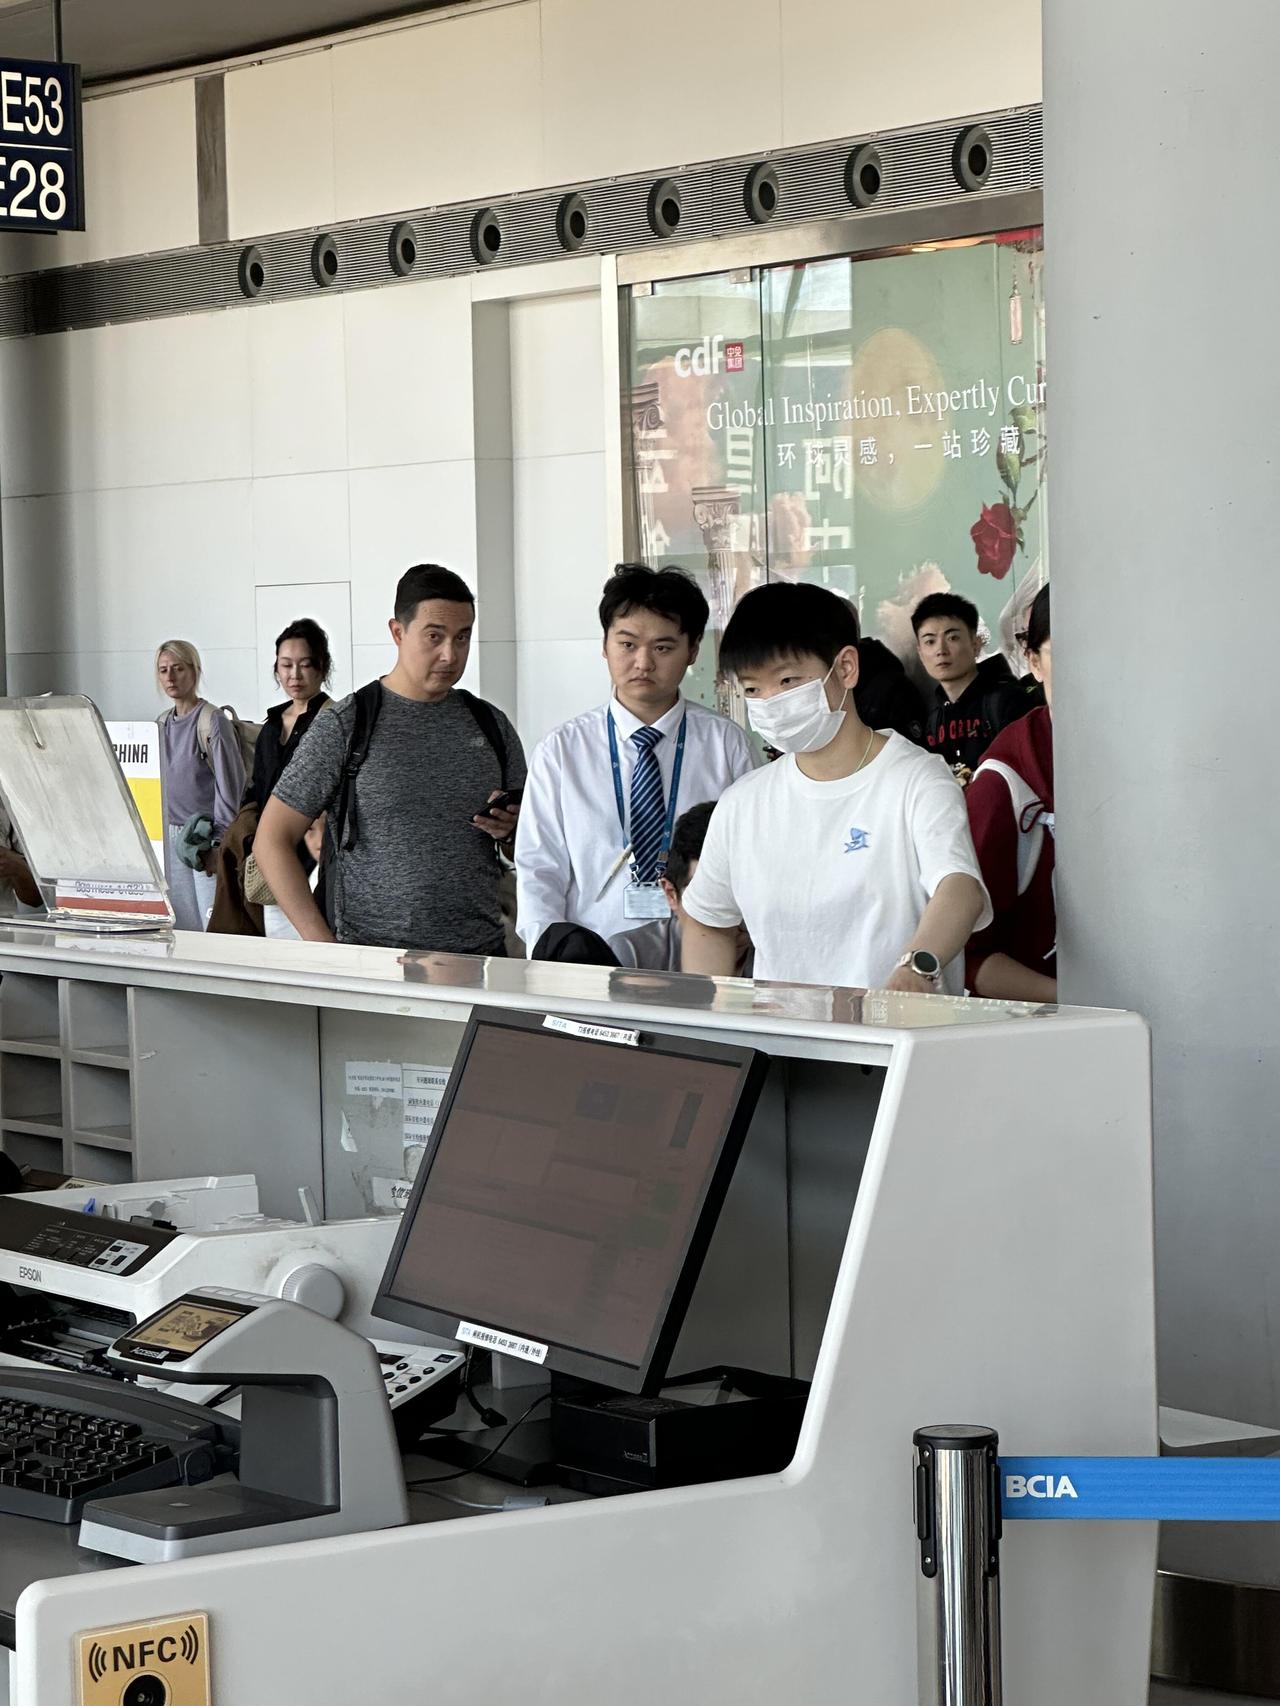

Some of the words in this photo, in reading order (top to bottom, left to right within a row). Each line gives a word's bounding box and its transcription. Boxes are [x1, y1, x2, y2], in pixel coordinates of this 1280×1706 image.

[1, 70, 64, 137] E53
[674, 334, 724, 378] cdf
[706, 398, 775, 431] Global
[782, 389, 901, 431] Inspiration,
[906, 378, 1000, 421] Expertly
[19, 1266, 42, 1283] EPSON
[1005, 1474, 1079, 1499] BCIA
[112, 1636, 178, 1672] NFC
